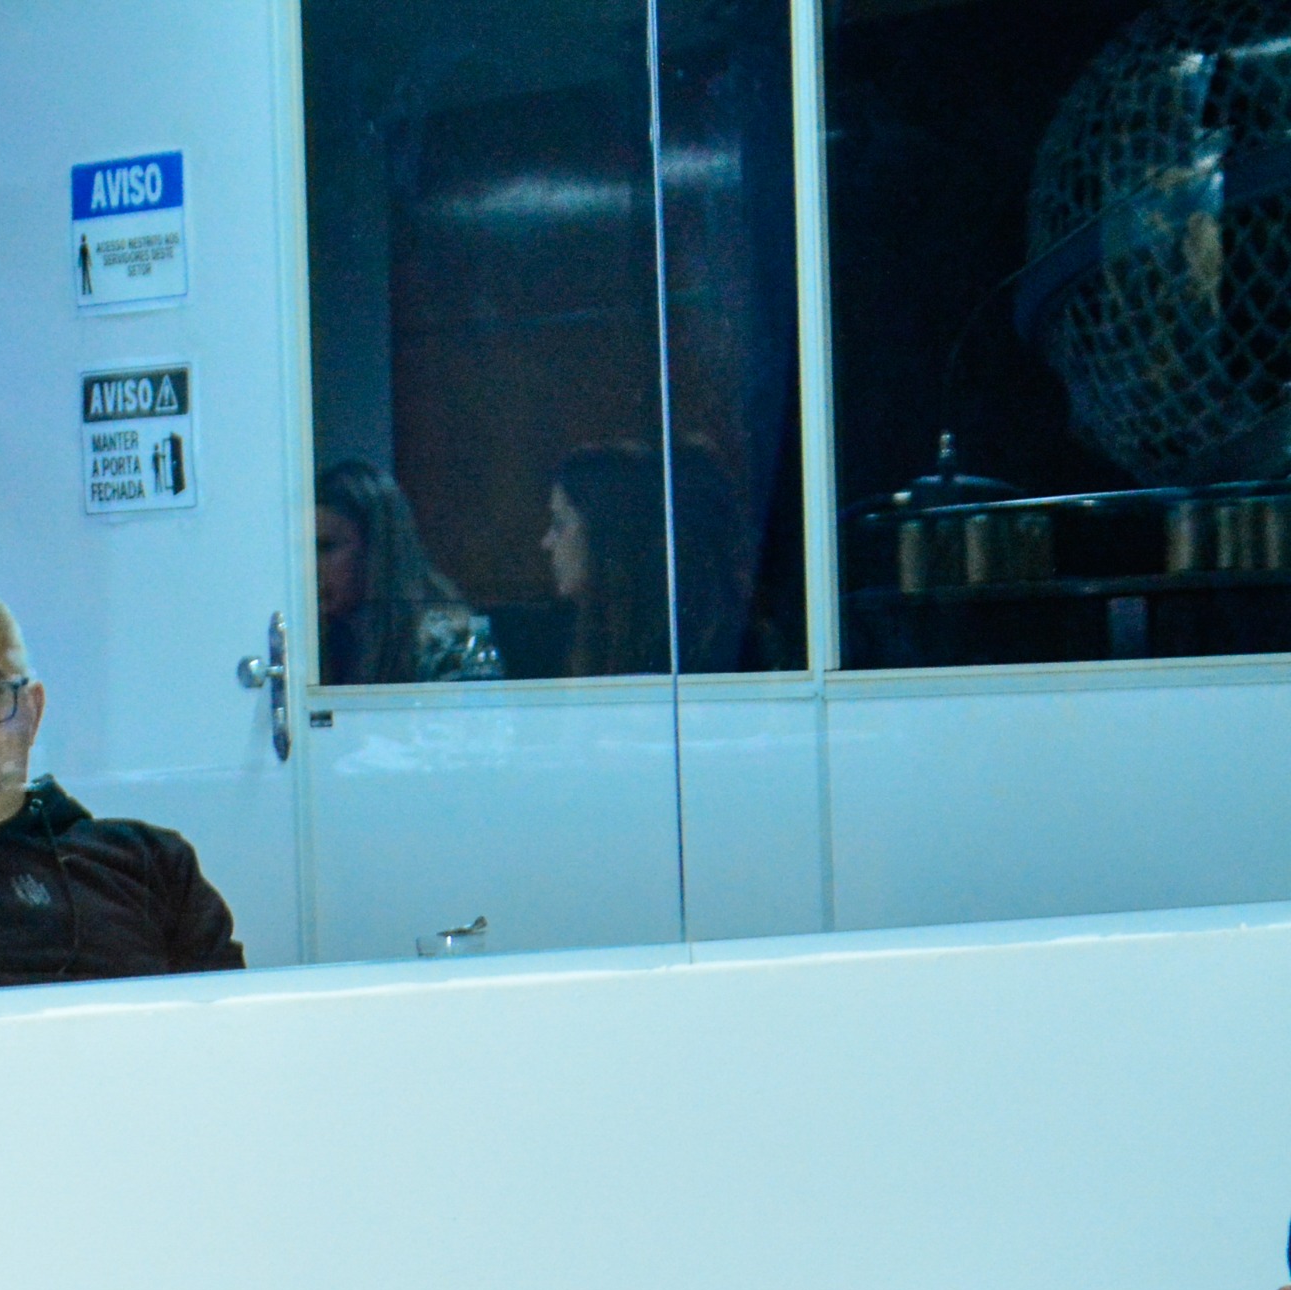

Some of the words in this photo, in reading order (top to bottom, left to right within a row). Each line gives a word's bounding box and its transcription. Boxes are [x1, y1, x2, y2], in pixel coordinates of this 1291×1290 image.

[91, 162, 162, 209] AVISO
[90, 377, 152, 414] AVISO
[92, 430, 139, 453] MANTER
[92, 457, 100, 478] A
[102, 455, 142, 477] PORTA
[91, 480, 146, 502] FECHADA
